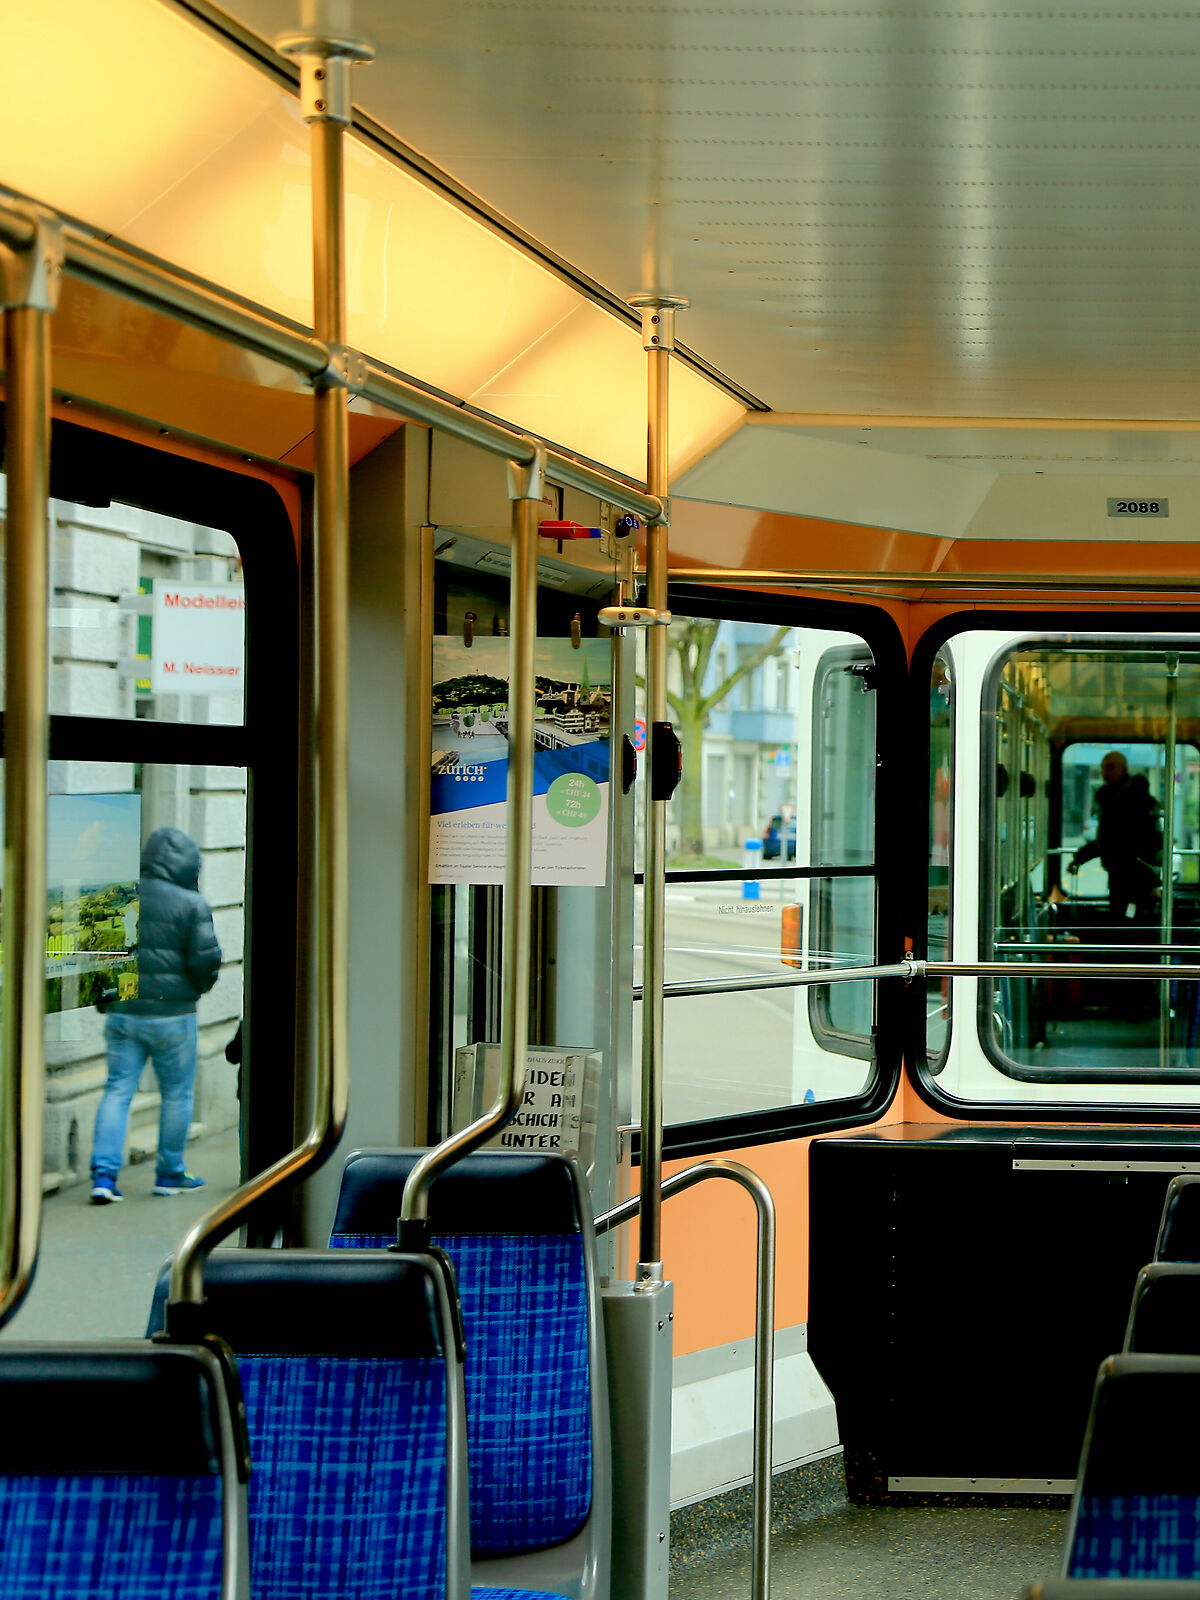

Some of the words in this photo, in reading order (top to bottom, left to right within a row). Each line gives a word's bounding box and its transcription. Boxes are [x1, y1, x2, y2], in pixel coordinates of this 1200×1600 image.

[1117, 502, 1160, 513] 2088
[453, 821, 480, 829] erleben
[501, 1133, 561, 1148] UNTER
